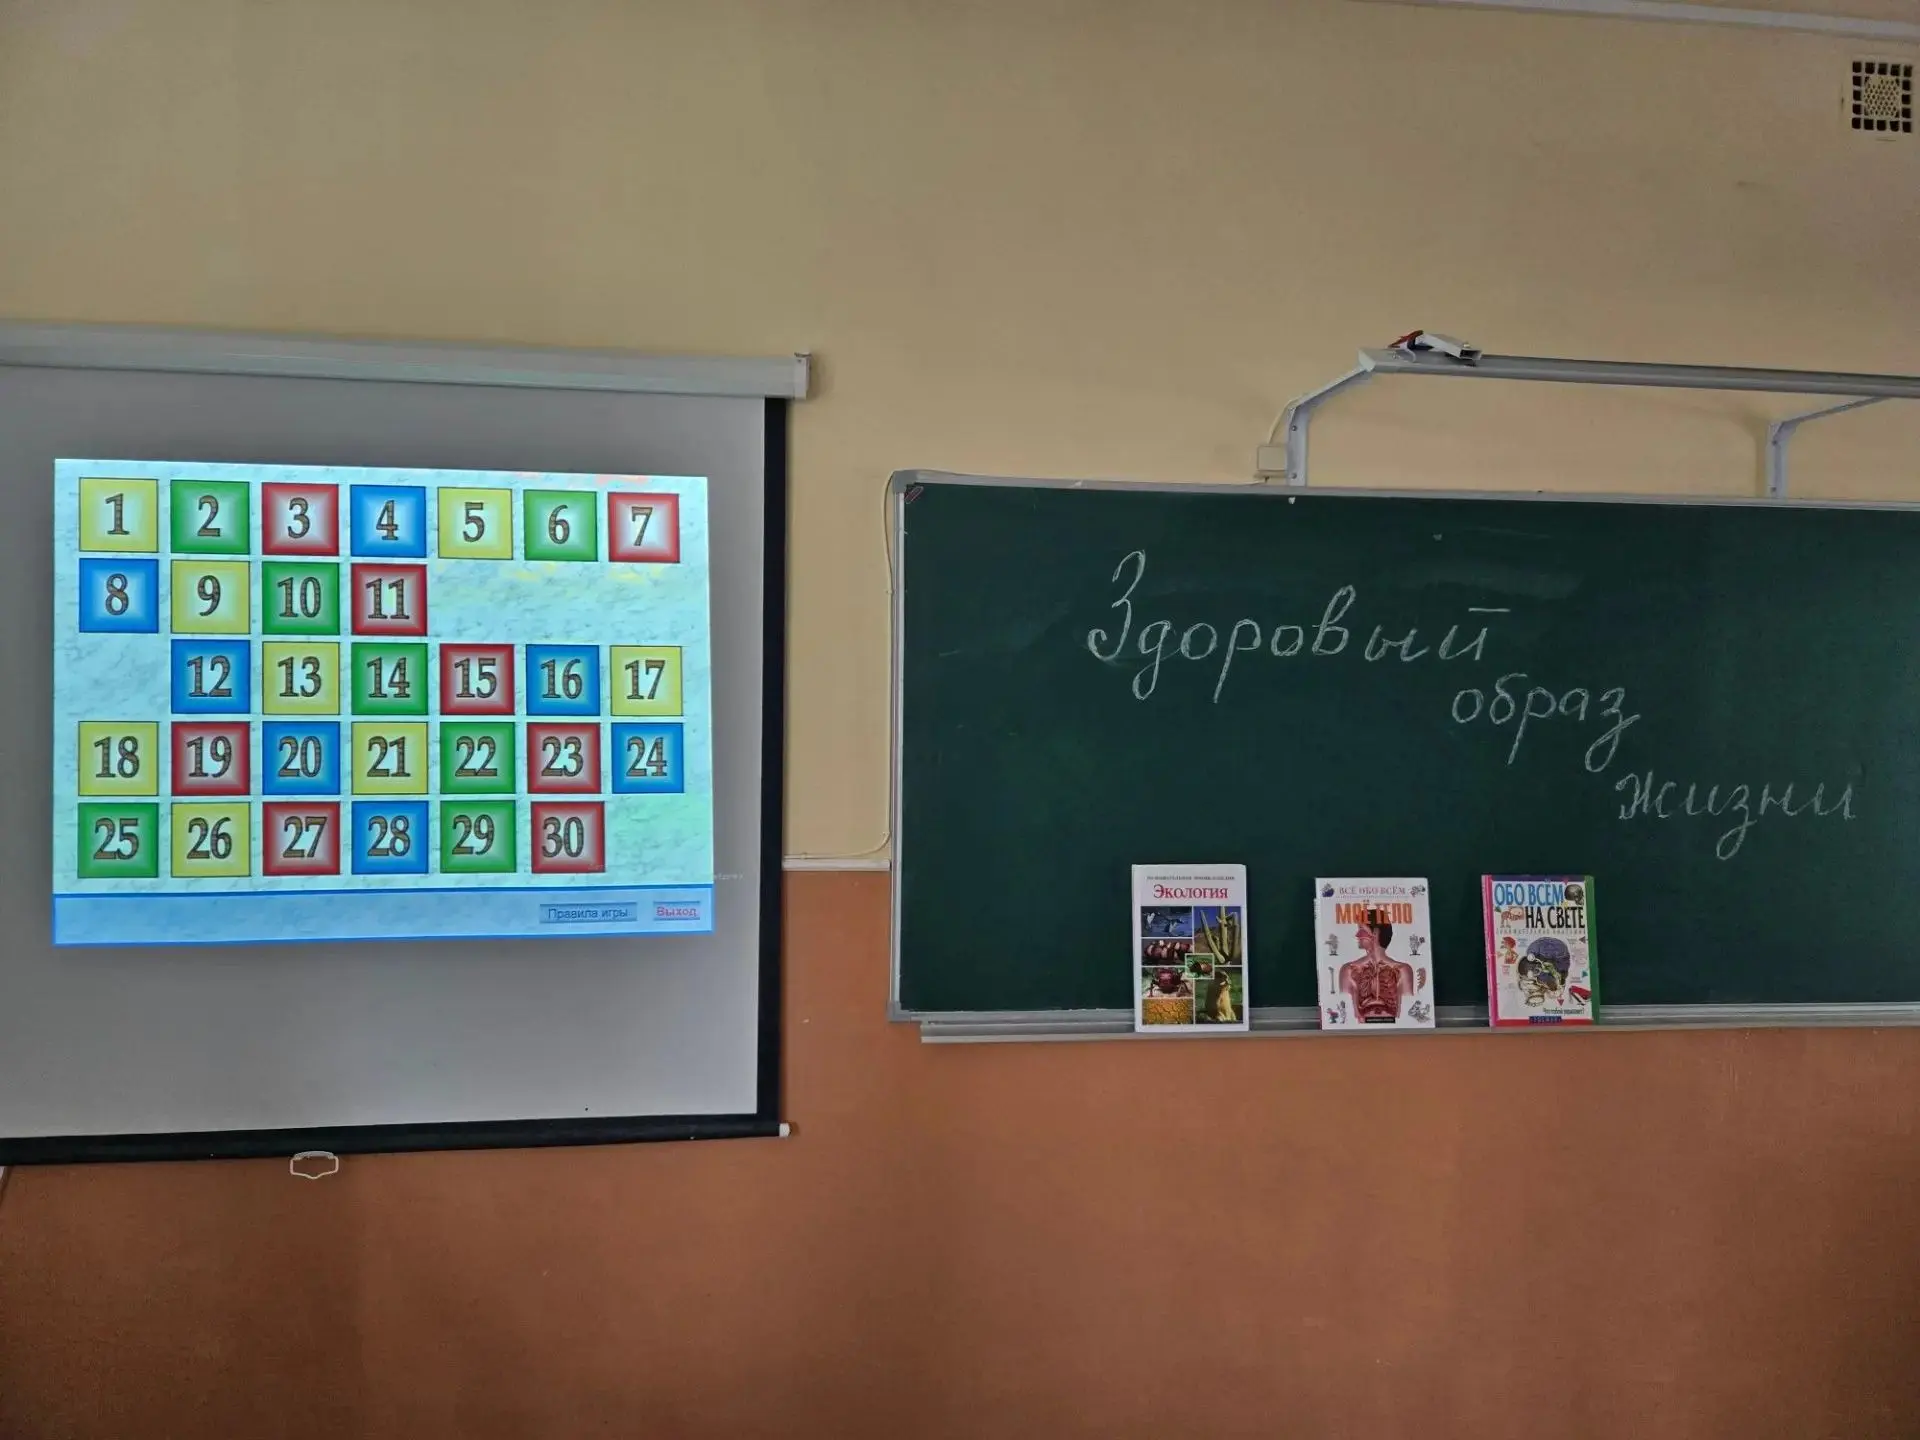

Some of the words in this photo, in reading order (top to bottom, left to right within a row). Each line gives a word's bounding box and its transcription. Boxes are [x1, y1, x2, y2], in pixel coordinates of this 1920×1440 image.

[106, 492, 126, 535] 1
[196, 495, 221, 538] 2
[287, 497, 310, 539] 3
[375, 500, 398, 541] 4
[462, 502, 485, 542] 5
[548, 505, 570, 545] 6
[631, 506, 653, 546] 7
[105, 573, 128, 616] 8
[197, 575, 220, 617] 9
[278, 577, 322, 618] 10
[367, 579, 410, 620] 11
[1086, 549, 1512, 704] Здоровый
[187, 656, 232, 698] 12
[278, 656, 322, 698] 13
[367, 657, 410, 698] 14
[455, 657, 497, 698] 15
[541, 658, 582, 699] 16
[625, 659, 666, 699] 17
[1451, 673, 1641, 773] образ
[94, 736, 140, 778] 18
[187, 736, 232, 778] 19
[277, 736, 322, 777] 20
[367, 736, 411, 777] 21
[455, 736, 498, 777] 22
[541, 736, 583, 776] 23
[626, 736, 667, 776] 24
[1615, 771, 1858, 861] жизни
[93, 818, 140, 860] 25
[187, 817, 232, 859] 26
[282, 817, 327, 858] 27
[367, 816, 411, 857] 28
[452, 815, 495, 855] 29
[541, 817, 583, 857] 30
[656, 906, 697, 917] Выход
[1153, 884, 1228, 898] Экология
[1495, 883, 1524, 905] ОБО
[548, 907, 597, 920] Правила
[602, 908, 628, 919] игры
[1375, 903, 1412, 924] ТЕЛО
[1526, 907, 1545, 928] НА
[1548, 907, 1585, 928] СВЕТЕ
